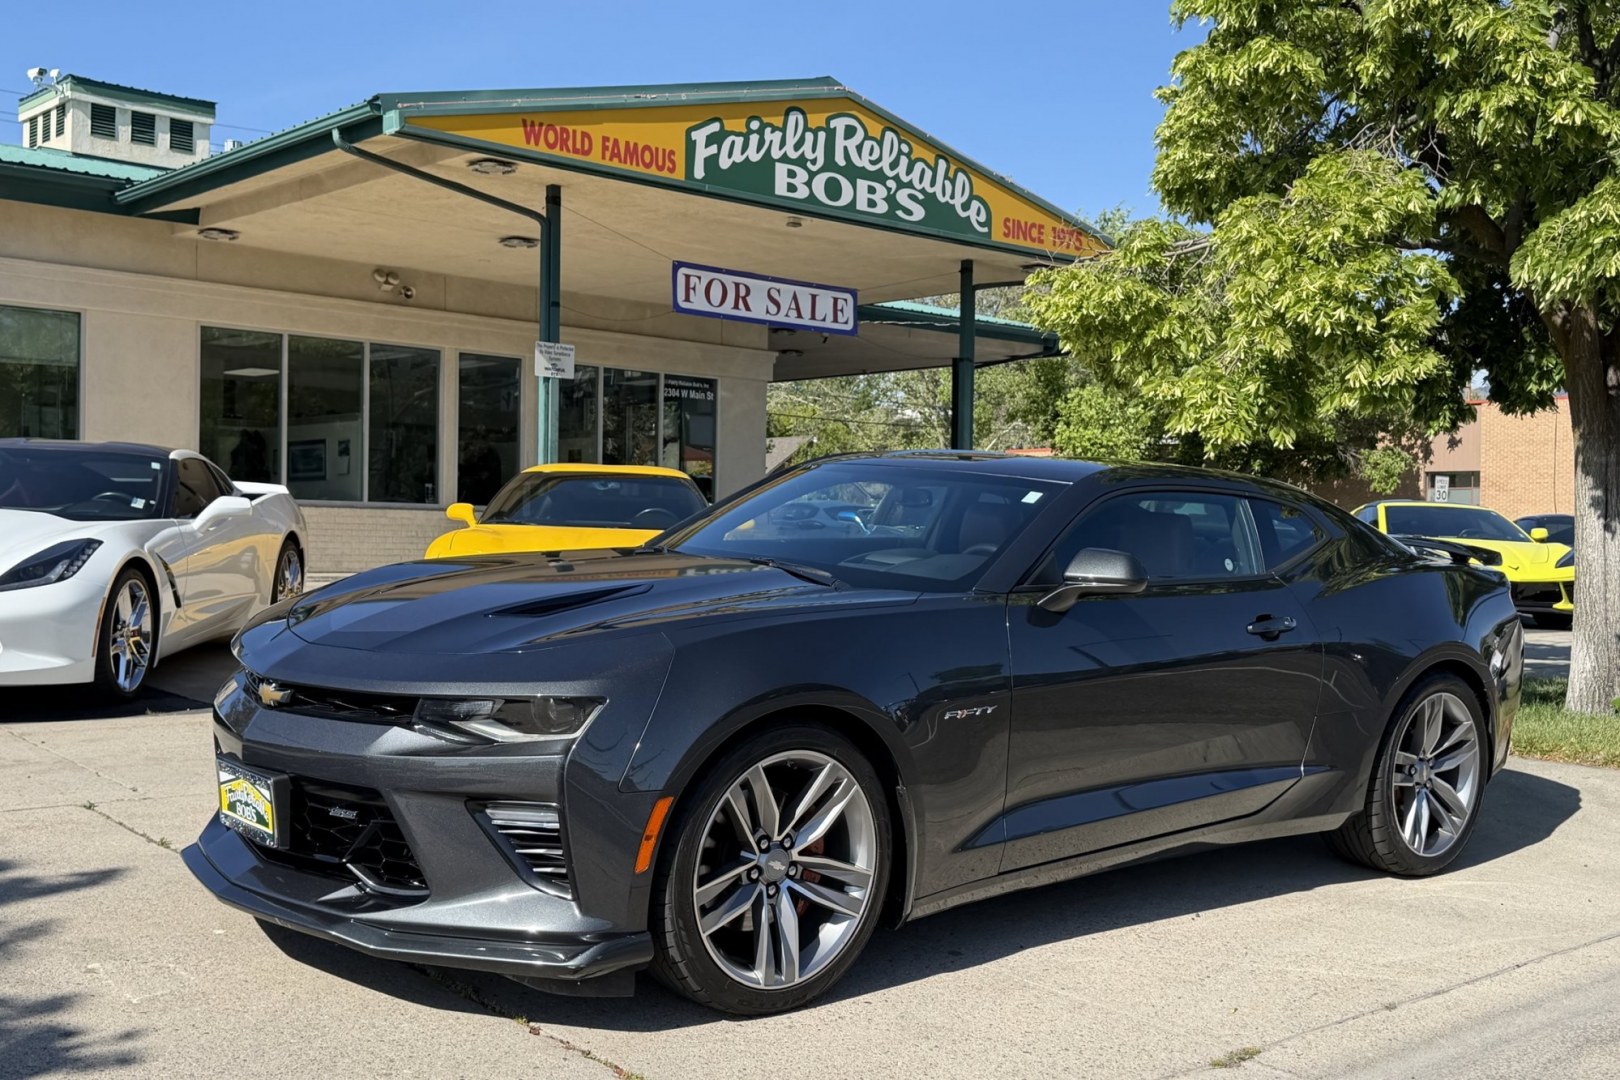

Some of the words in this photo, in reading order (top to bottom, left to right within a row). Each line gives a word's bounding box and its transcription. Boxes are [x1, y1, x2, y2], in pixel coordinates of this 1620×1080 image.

[522, 118, 593, 157] WORLD
[601, 135, 676, 174] FAMOUS
[691, 108, 826, 181] Fairly
[829, 114, 989, 233] Reliable
[774, 161, 927, 222] BOB'S
[1002, 217, 1045, 245] SINCE
[682, 273, 752, 312] FOR
[765, 286, 850, 325] SALE
[664, 387, 680, 398] 2304
[681, 388, 688, 398] W
[689, 390, 705, 400] Main
[706, 391, 714, 400] St
[1436, 490, 1447, 500] 30
[236, 802, 257, 823] BOB'S
